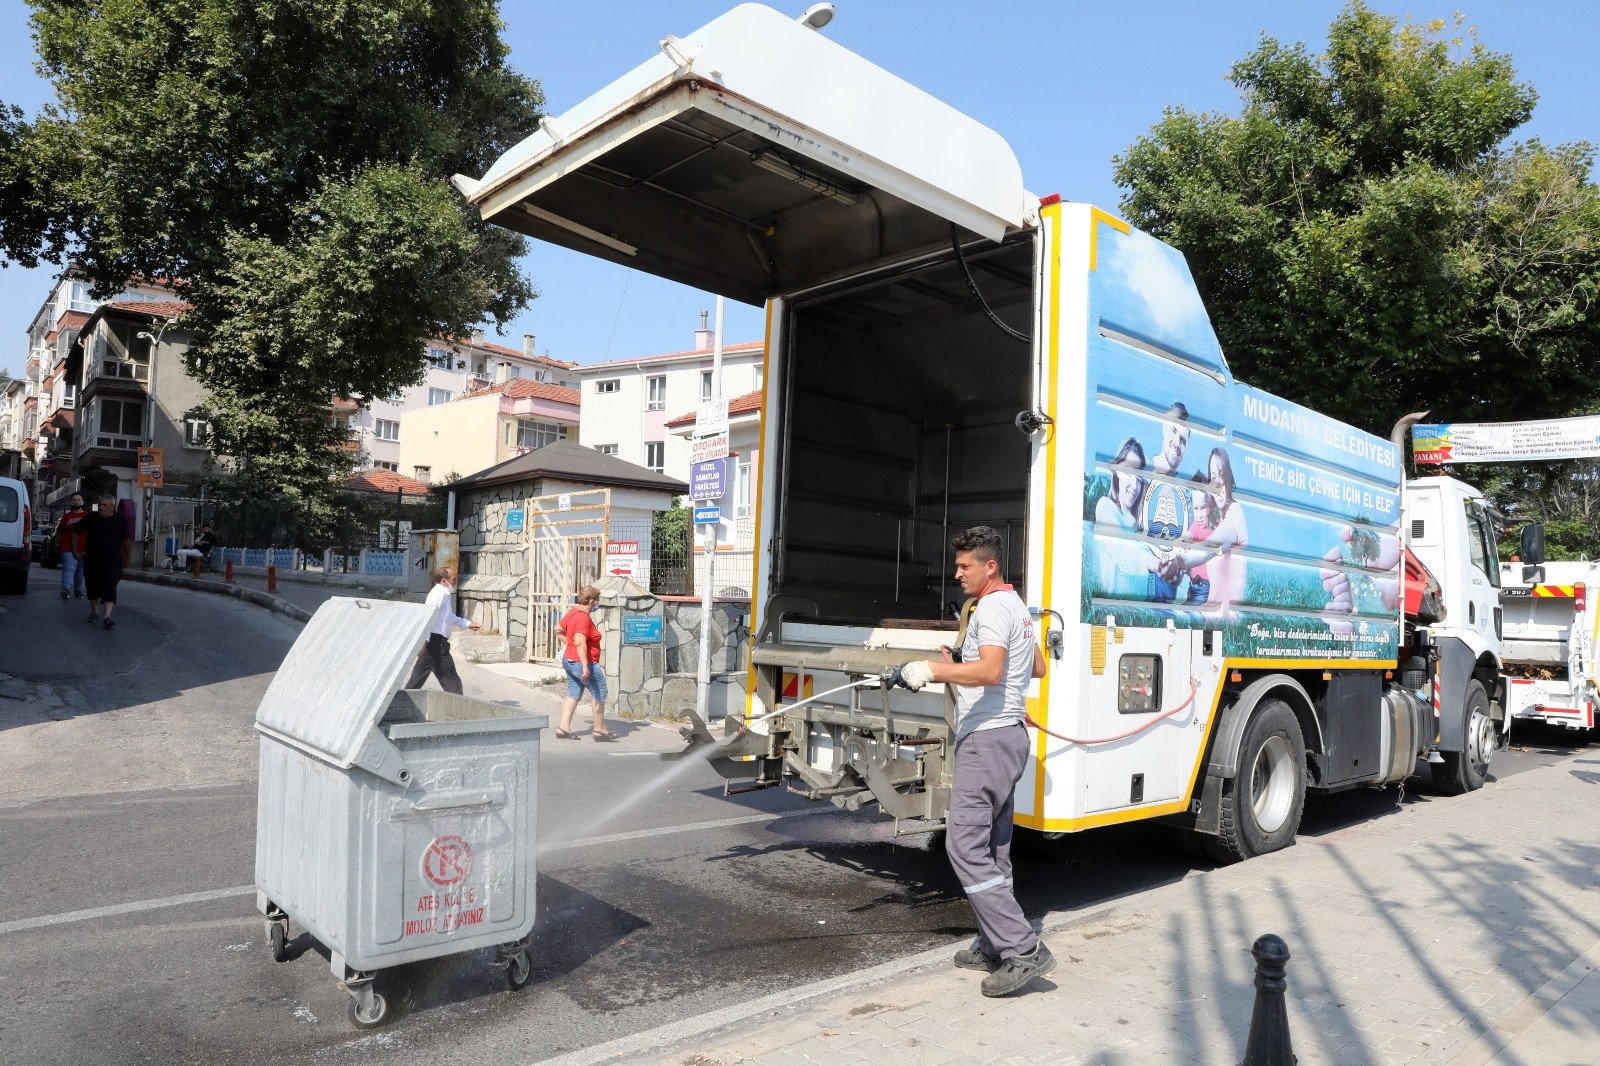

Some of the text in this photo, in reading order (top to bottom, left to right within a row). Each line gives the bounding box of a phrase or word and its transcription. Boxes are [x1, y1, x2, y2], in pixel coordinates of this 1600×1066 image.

[1243, 394, 1395, 469] MUDANYA BELEDİYESİ
[692, 436, 727, 453] OTOPARK
[692, 446, 728, 463] OTO YIKAMA
[700, 462, 716, 472] GÜZEL
[694, 480, 720, 491] FAKÜLTESİ
[1287, 467, 1307, 491] BİR
[1308, 476, 1340, 500] ÇEVRE
[1342, 481, 1361, 507] İÇİN
[1363, 491, 1374, 509] EL
[607, 543, 638, 554] FOTO HAKAN
[1273, 627, 1287, 640] bize
[1288, 628, 1333, 642] dedelerimizden
[1350, 632, 1359, 642] bir
[1256, 645, 1301, 657] torunlarımıza
[1302, 645, 1343, 660] bırakacağımız
[1343, 647, 1352, 657] bir
[406, 917, 438, 936] MOLOZ
